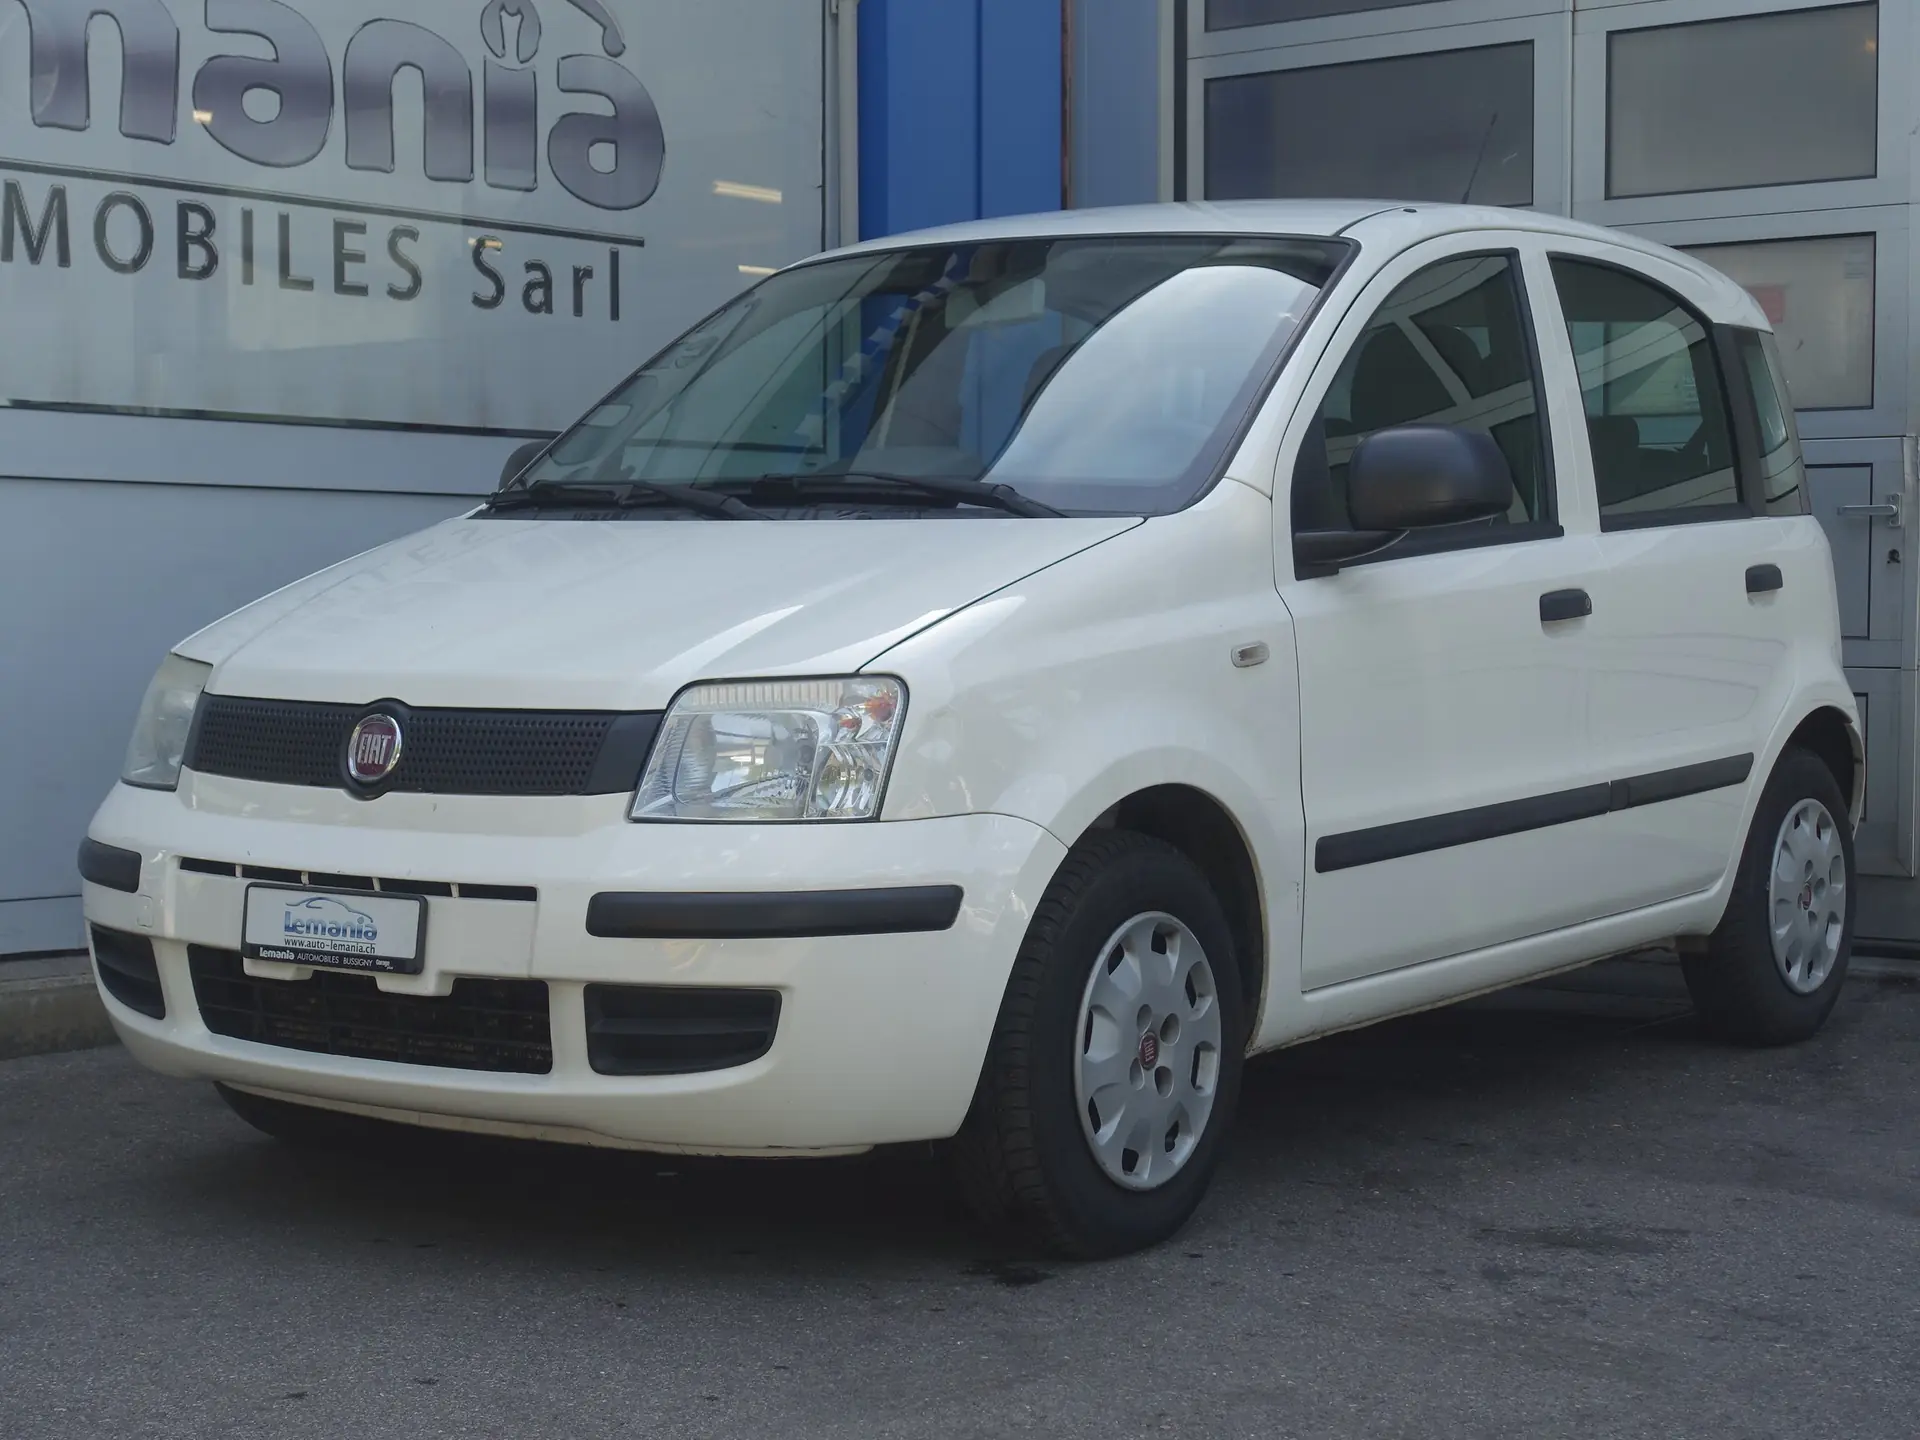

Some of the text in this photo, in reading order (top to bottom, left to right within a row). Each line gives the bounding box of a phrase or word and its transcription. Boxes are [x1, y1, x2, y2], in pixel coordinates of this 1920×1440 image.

[0, 178, 620, 321] MOBILES Sarl
[357, 733, 391, 765] FIAT
[284, 910, 377, 941] Lemania
[259, 947, 295, 960] Lemania
[297, 952, 339, 964] AUTOMOBILES
[343, 957, 373, 967] BUSSIGNY
[284, 937, 376, 954] www.auto-lemania.ch
